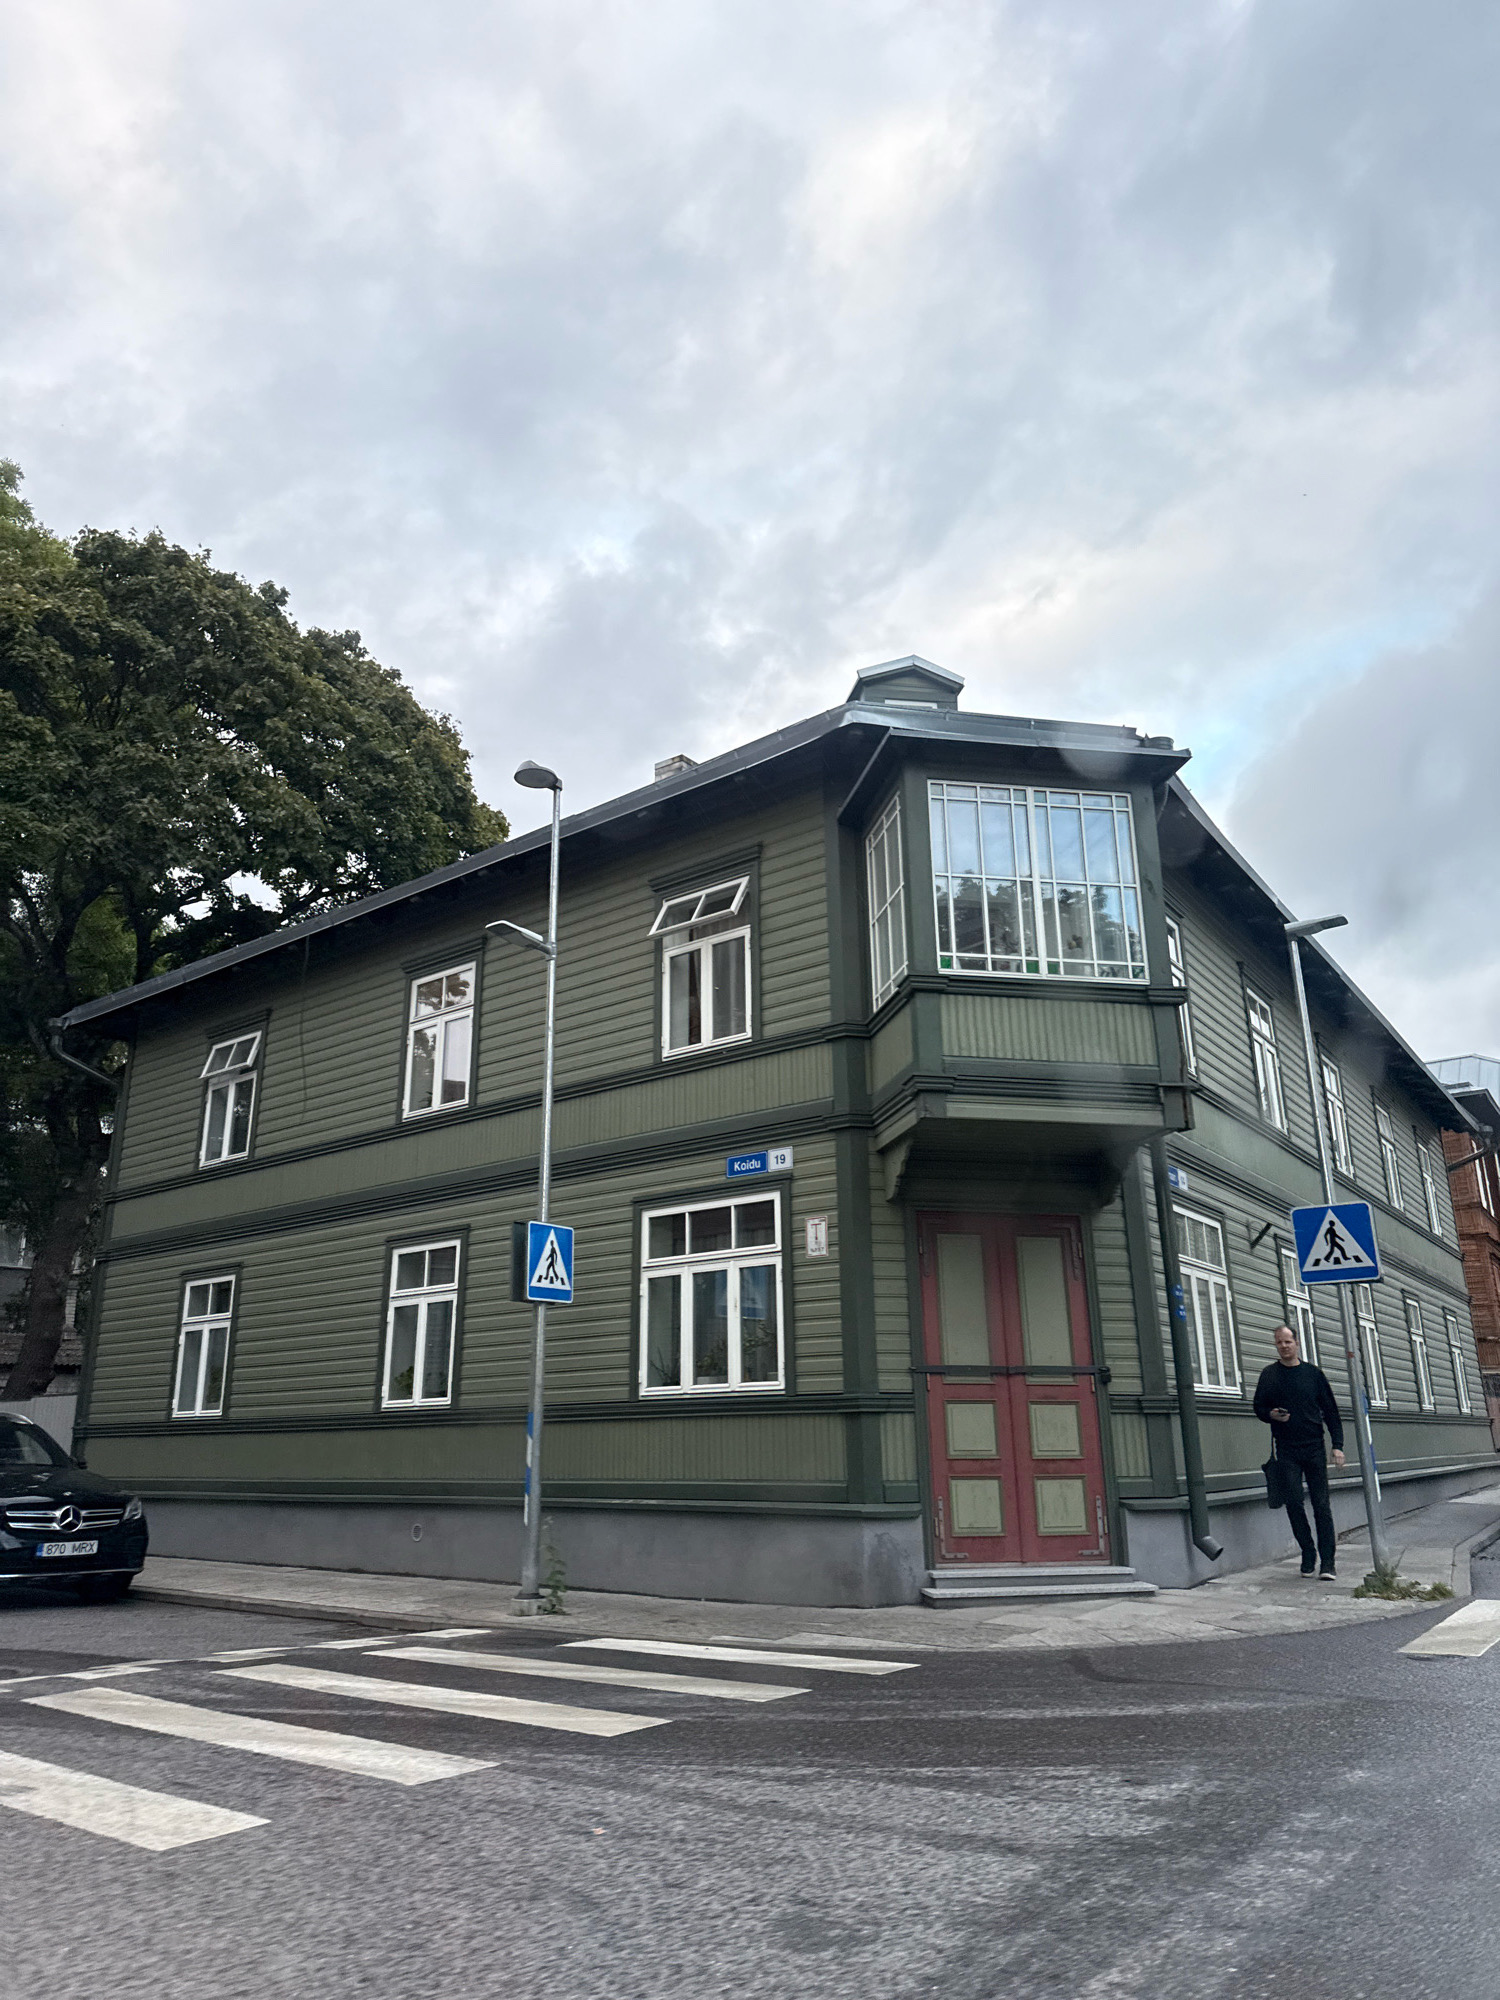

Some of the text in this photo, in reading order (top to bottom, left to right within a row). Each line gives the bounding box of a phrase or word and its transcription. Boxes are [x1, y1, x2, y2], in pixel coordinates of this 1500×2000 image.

[734, 1154, 786, 1171] Koidu 19
[46, 1543, 66, 1555] 870
[72, 1542, 95, 1553] MRX
